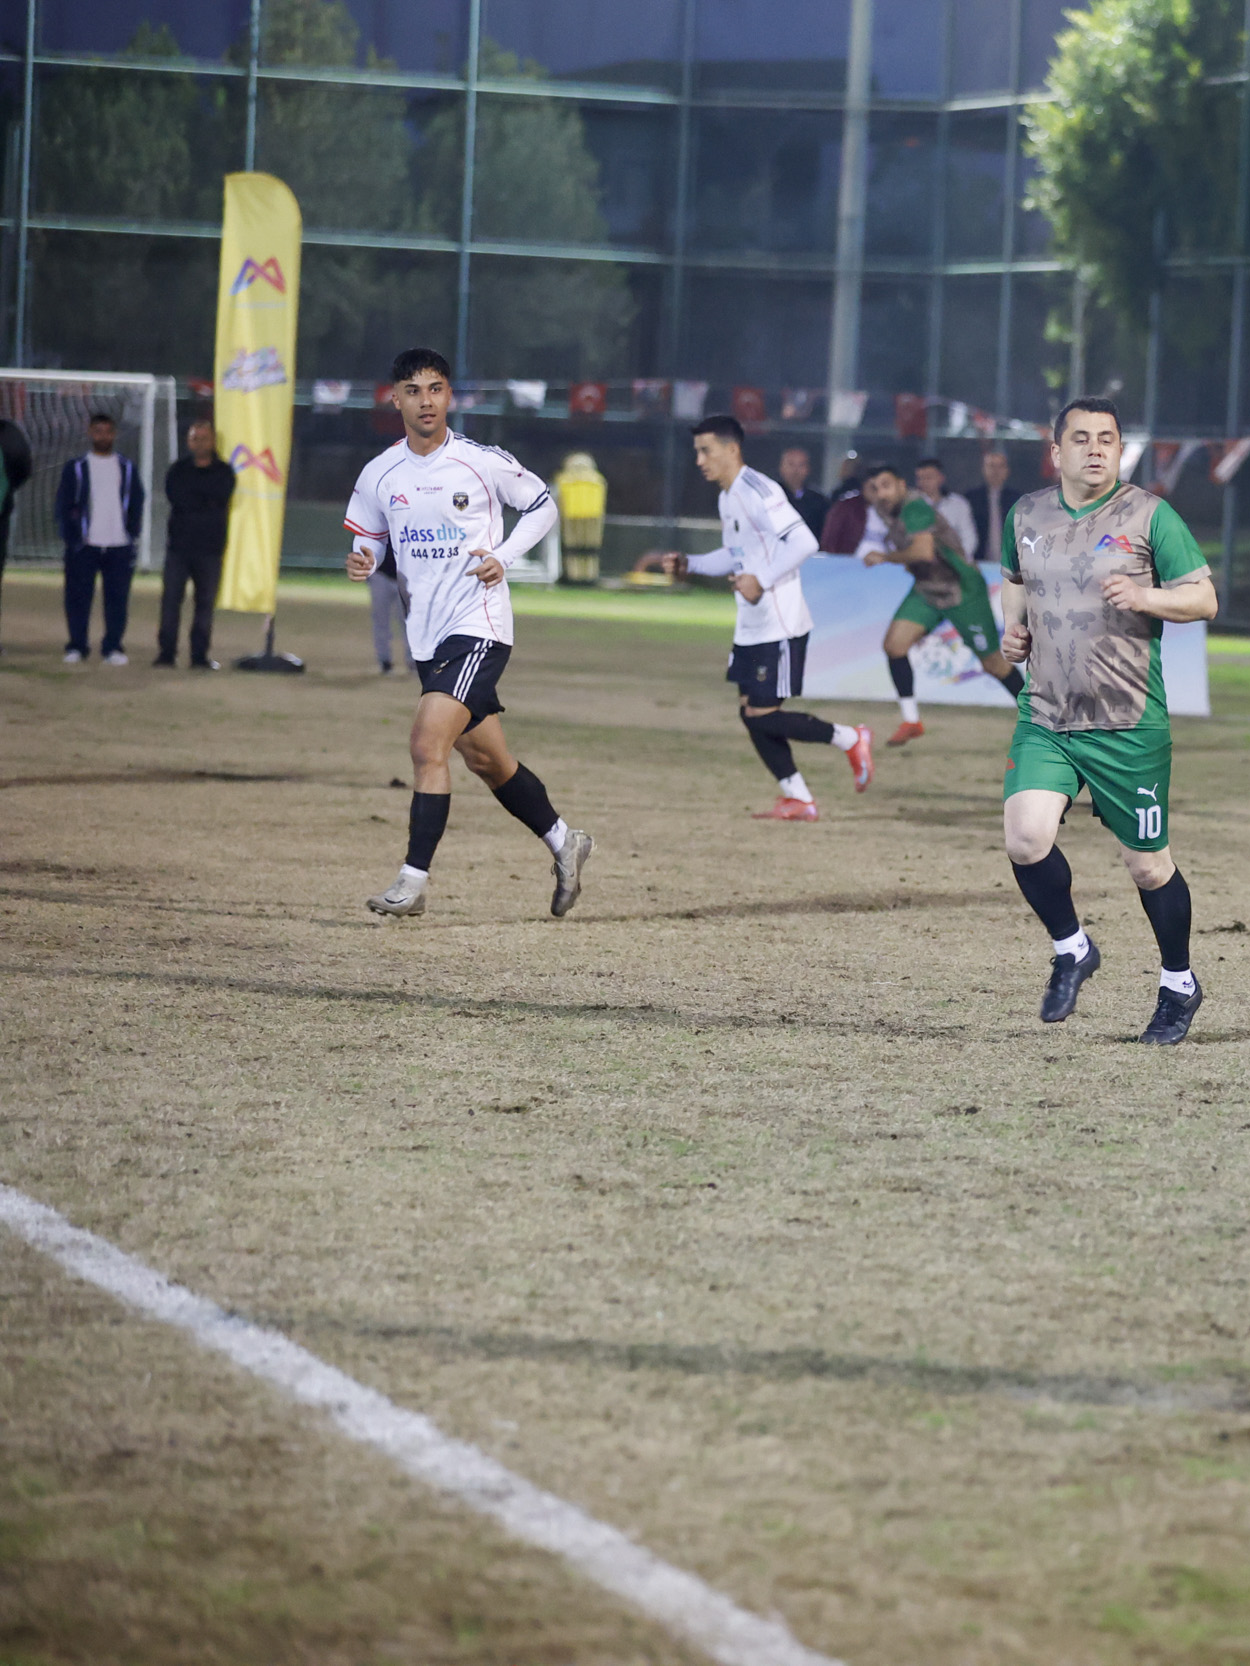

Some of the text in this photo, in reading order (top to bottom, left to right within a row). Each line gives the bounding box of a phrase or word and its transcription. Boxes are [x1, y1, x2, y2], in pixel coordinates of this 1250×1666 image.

[411, 547, 428, 559] 444
[431, 547, 445, 559] 22
[1135, 804, 1162, 840] 10
